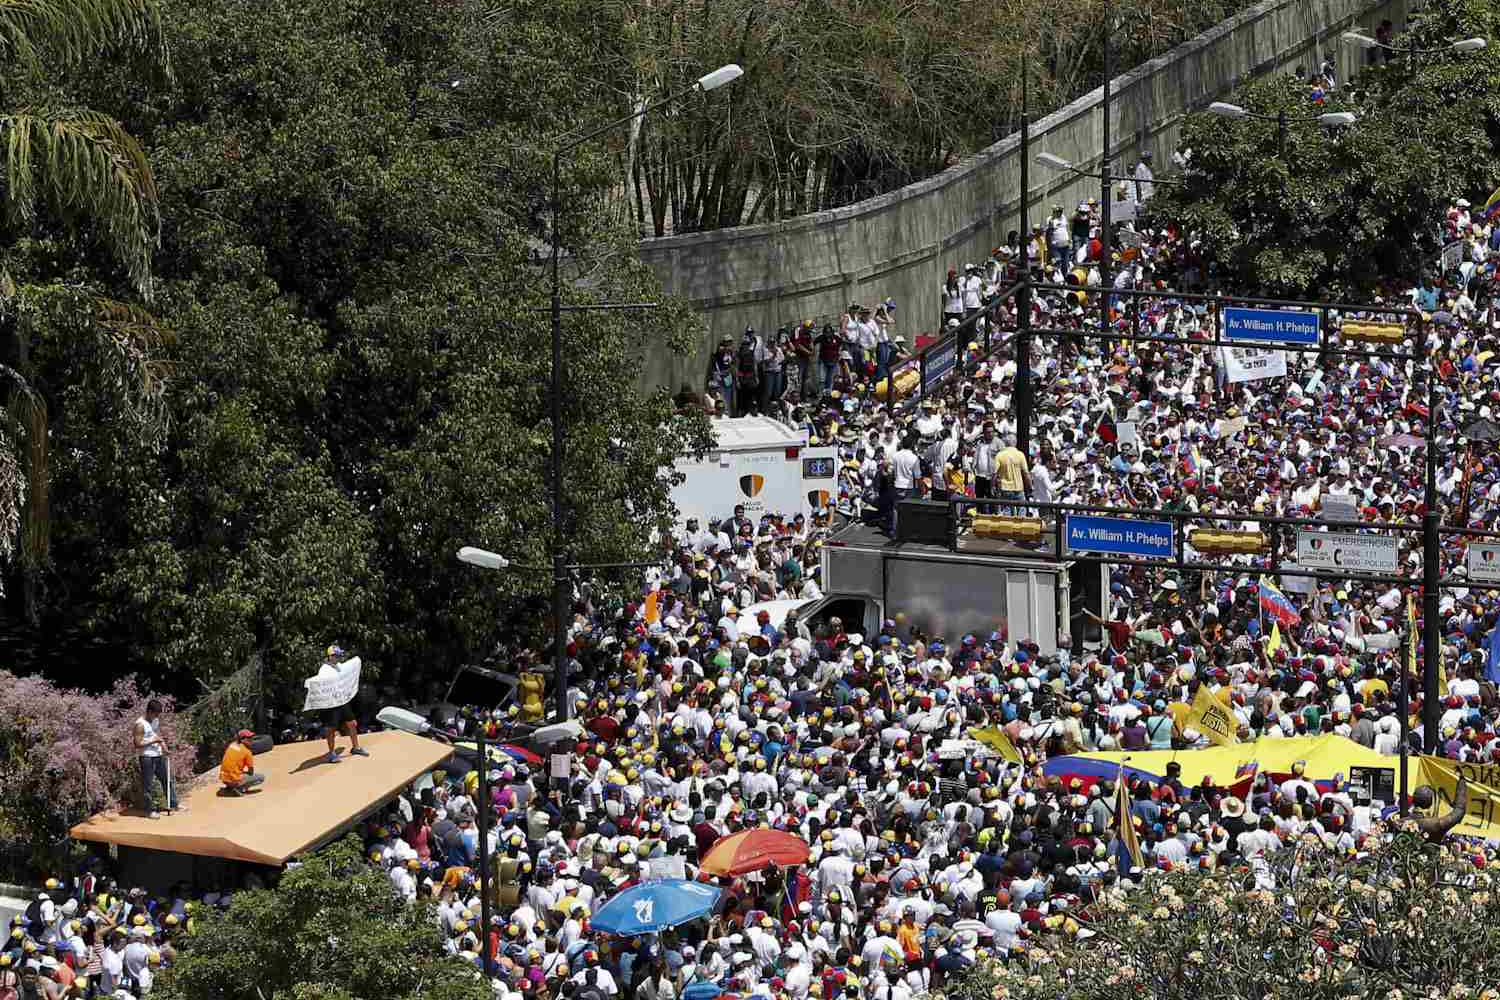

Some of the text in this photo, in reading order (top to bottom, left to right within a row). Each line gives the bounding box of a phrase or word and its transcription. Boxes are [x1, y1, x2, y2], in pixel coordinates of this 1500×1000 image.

[1229, 319, 1243, 329] Av.
[1244, 319, 1274, 331] William
[1286, 321, 1316, 337] Phelps
[1072, 527, 1169, 548] Av. William H. Phelps
